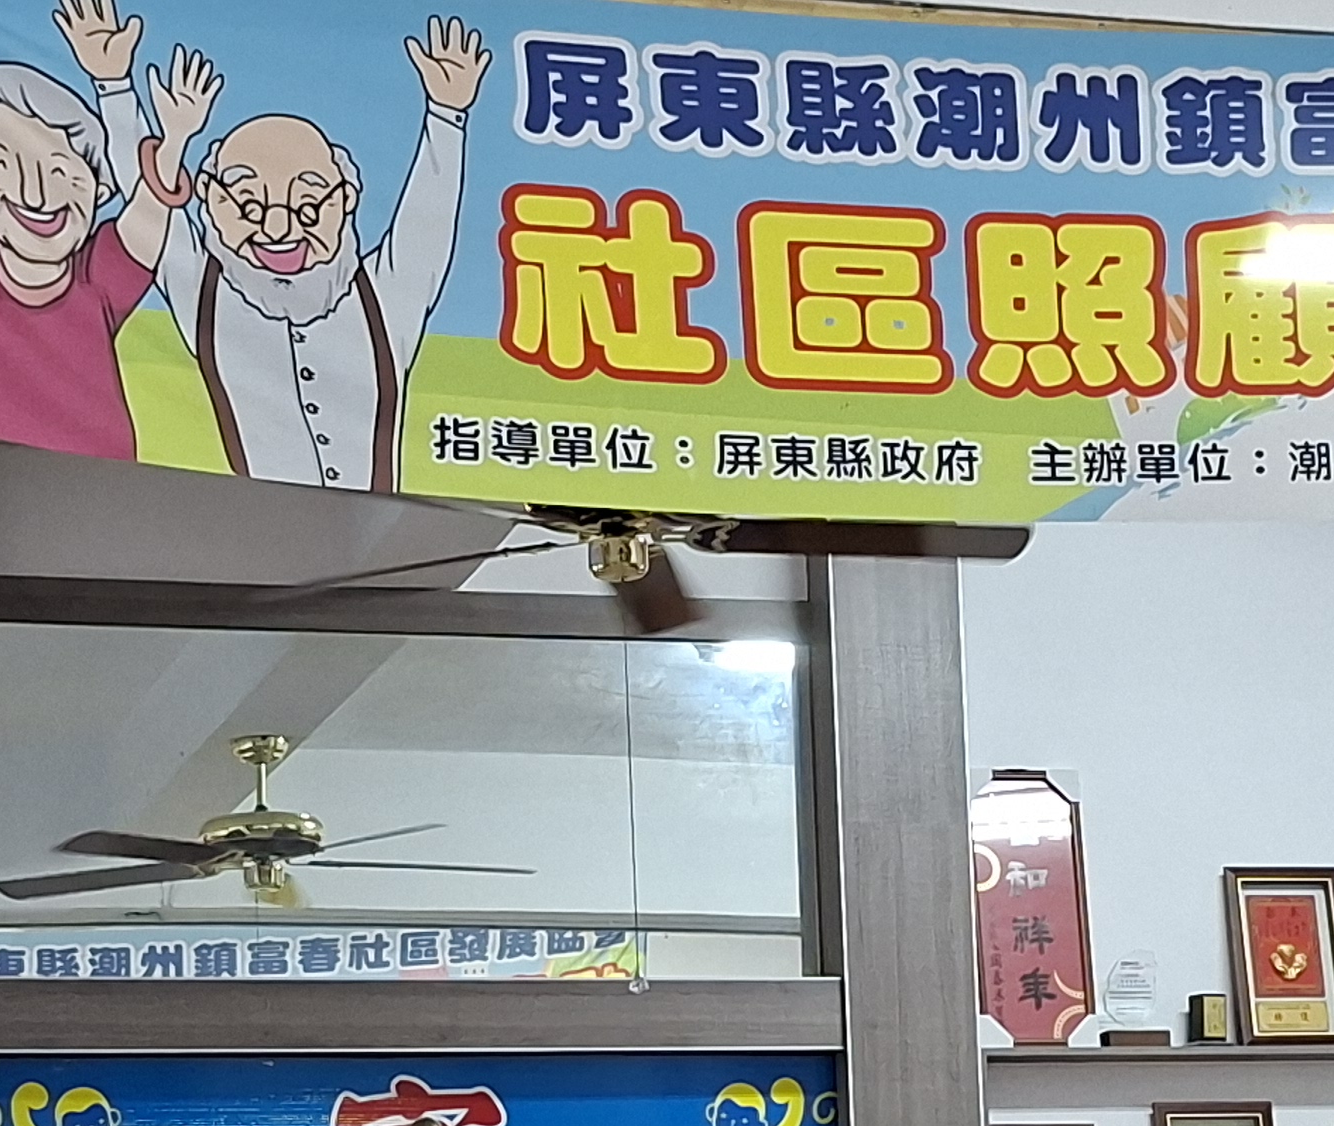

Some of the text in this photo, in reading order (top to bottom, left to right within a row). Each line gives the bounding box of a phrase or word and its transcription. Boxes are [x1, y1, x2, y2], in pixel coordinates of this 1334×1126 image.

[432, 416, 981, 484] 指導單位：屏東縣政府
